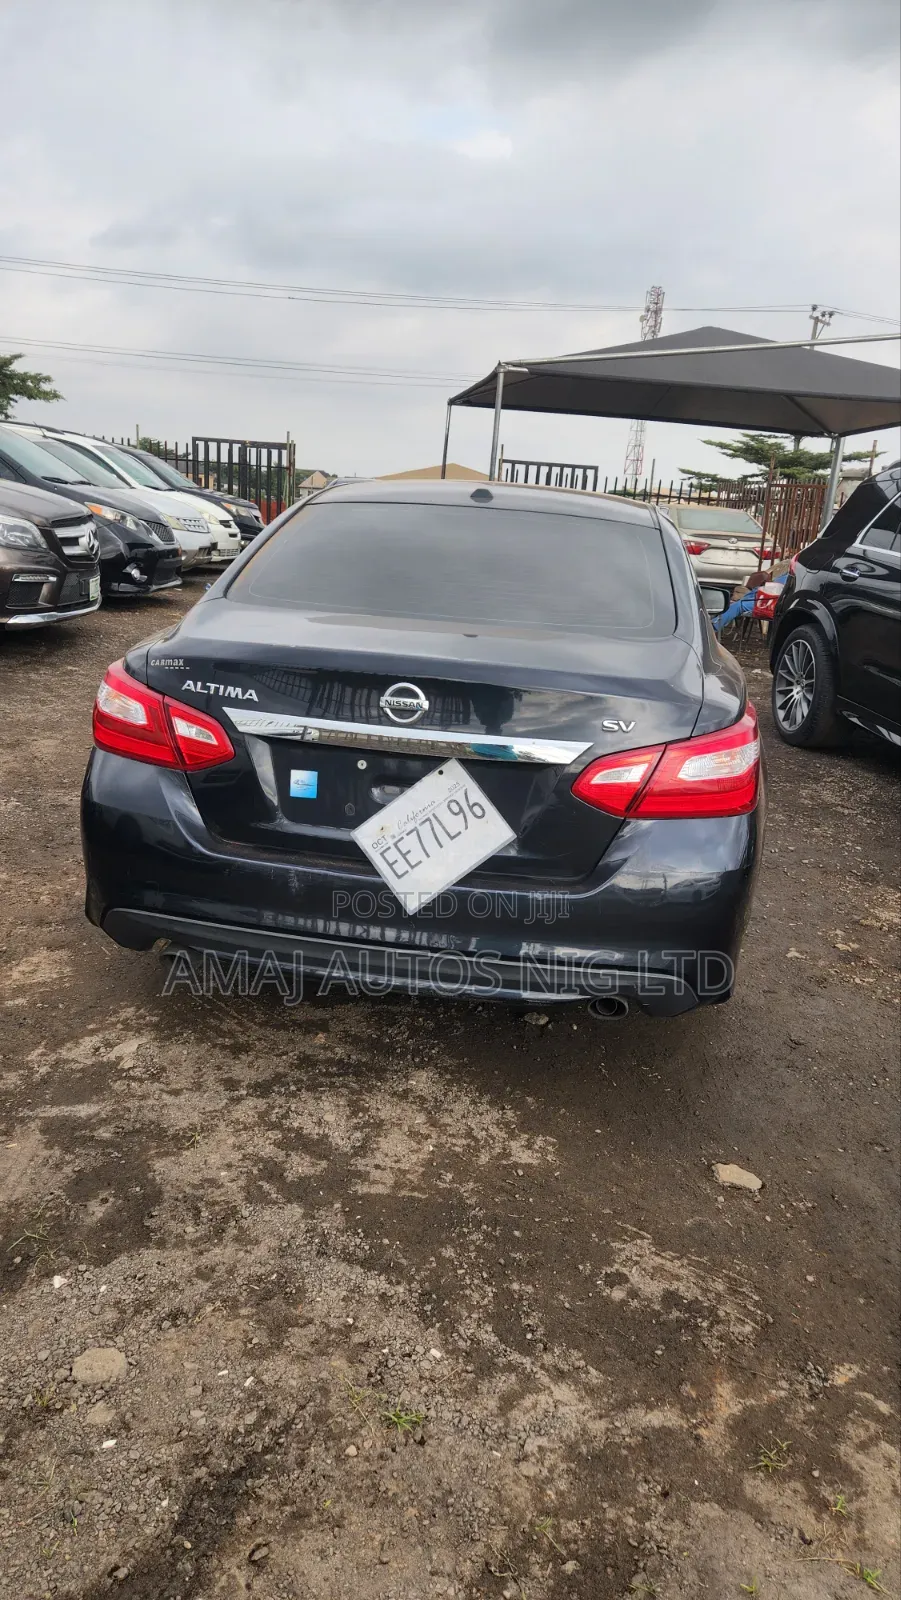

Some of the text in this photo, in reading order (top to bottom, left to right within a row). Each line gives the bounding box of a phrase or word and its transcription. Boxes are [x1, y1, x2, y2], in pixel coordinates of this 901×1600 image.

[181, 679, 259, 702] ALTIMA
[384, 699, 424, 709] NISSAN
[601, 719, 637, 733] SV
[371, 834, 388, 850] OCT
[396, 800, 435, 830] California
[379, 787, 486, 880] EE77L96
